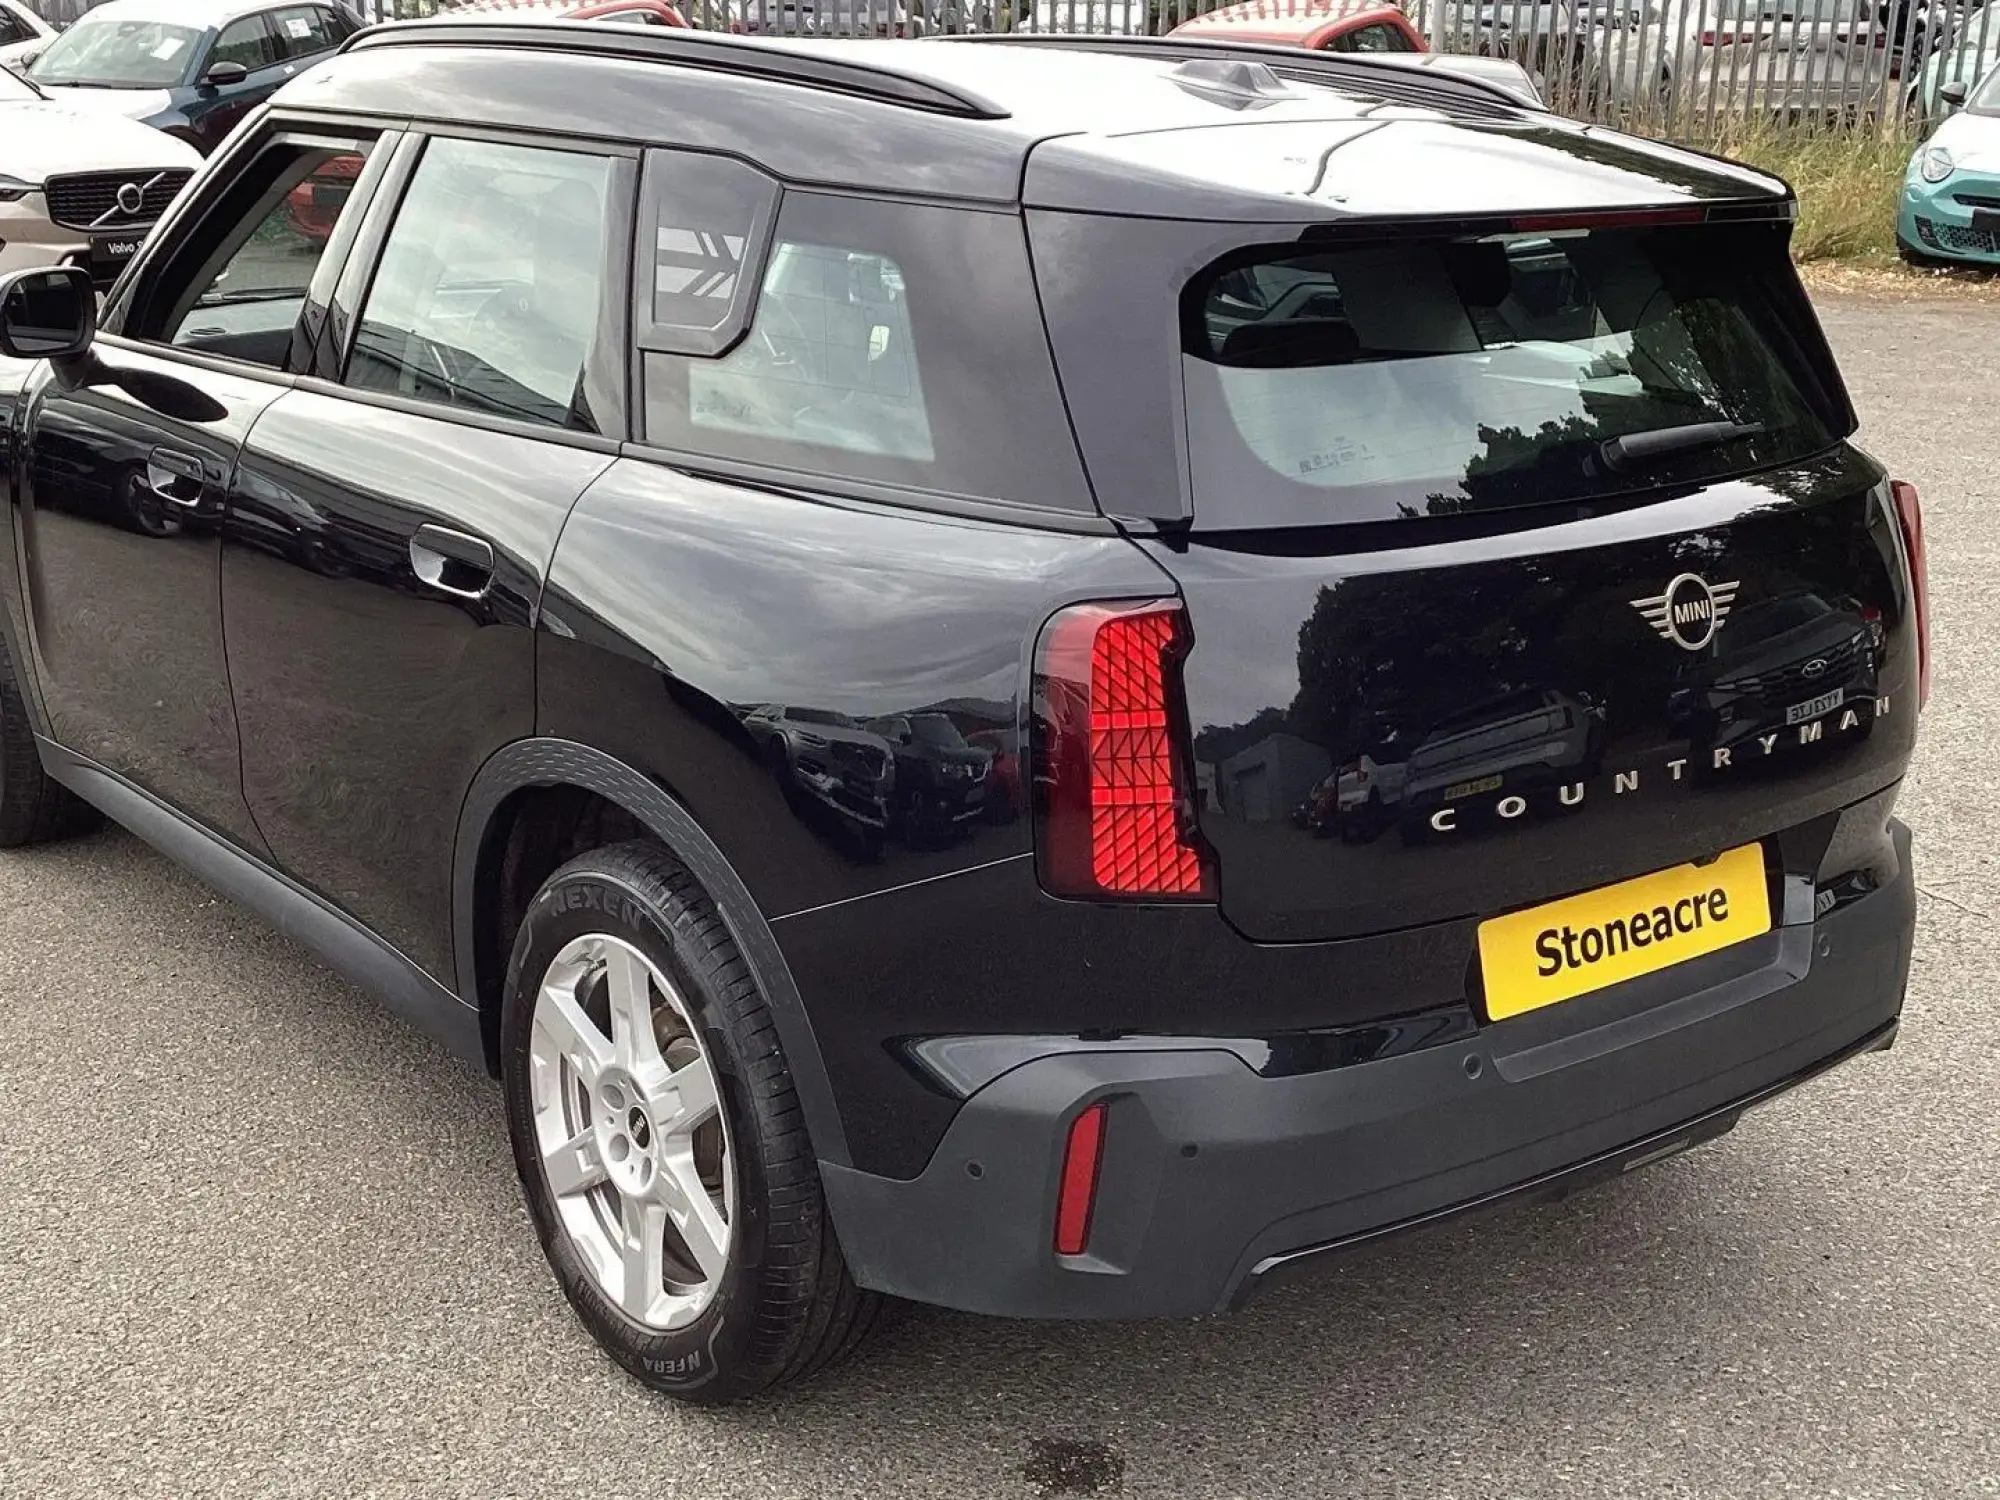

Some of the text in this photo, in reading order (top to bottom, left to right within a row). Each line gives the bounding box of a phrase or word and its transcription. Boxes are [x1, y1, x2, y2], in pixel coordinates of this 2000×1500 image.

[107, 242, 135, 254] Volvo
[1674, 600, 1711, 624] MINI
[1431, 695, 1890, 831] COUNTRYMAN
[550, 885, 641, 931] NEXEN
[1535, 888, 1729, 977] Stoneacre
